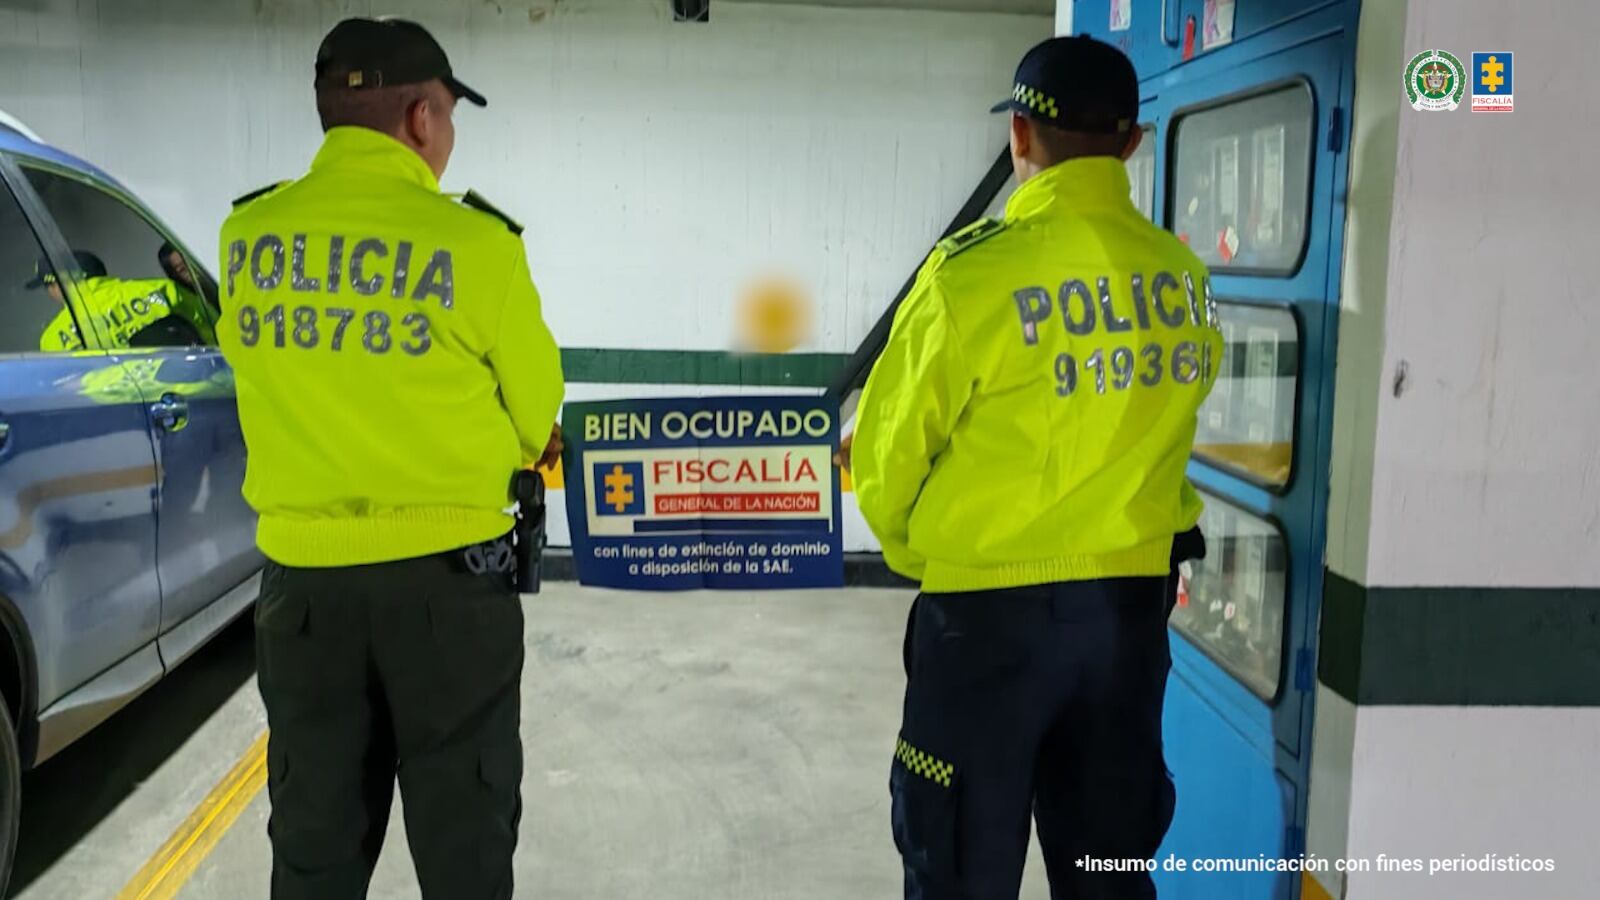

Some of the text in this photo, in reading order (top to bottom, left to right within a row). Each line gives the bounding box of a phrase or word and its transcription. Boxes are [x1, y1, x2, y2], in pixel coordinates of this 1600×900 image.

[227, 233, 454, 309] POLICIA
[239, 303, 432, 355] 918783
[584, 408, 831, 442] BIEN OCUPADO
[653, 451, 818, 484] FISCALÍA
[659, 492, 817, 512] GENERAL DE LA NACIÓN
[593, 541, 830, 559] con fines de extinción de dominio
[628, 559, 793, 577] a disposición de la SAE.
